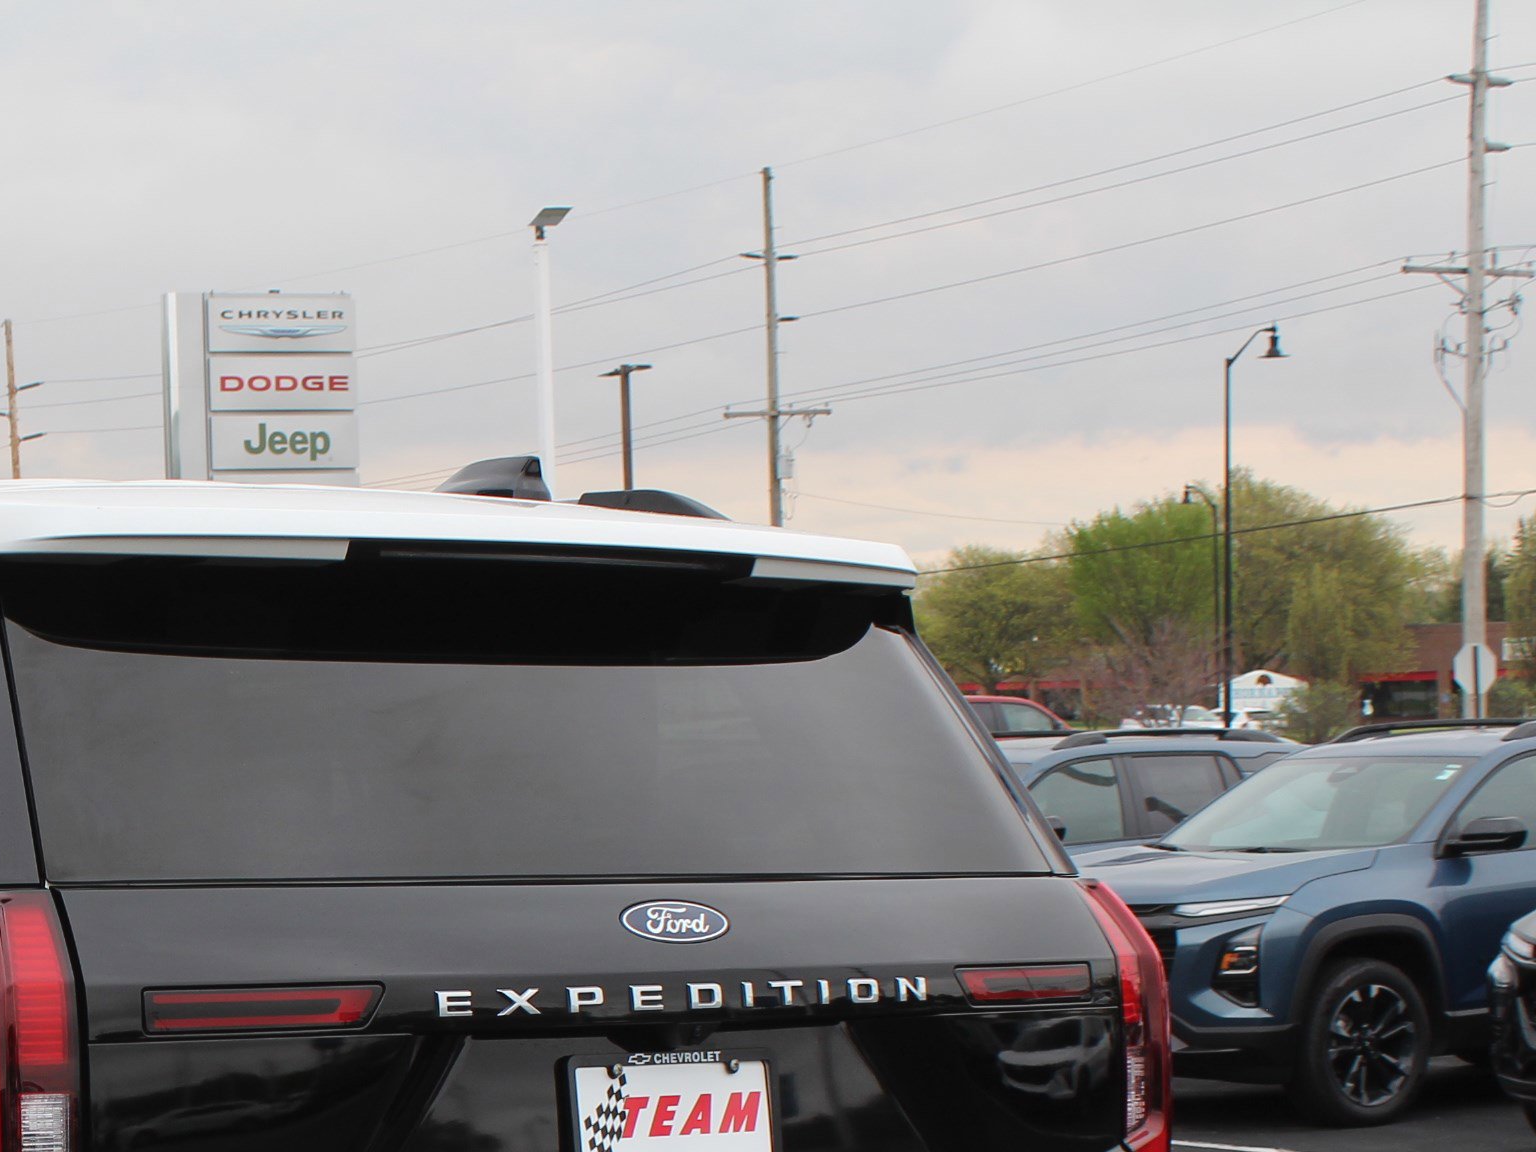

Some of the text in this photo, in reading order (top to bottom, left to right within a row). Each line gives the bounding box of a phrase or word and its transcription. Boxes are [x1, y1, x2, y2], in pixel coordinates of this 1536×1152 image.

[220, 309, 345, 320] CHRYSLER
[219, 375, 349, 392] DODGE
[243, 422, 331, 461] Jeep
[646, 906, 710, 933] Ford
[434, 976, 927, 1017] EXPEDITION
[653, 1051, 721, 1064] CHEVROLET
[621, 1091, 762, 1138] TEAM
